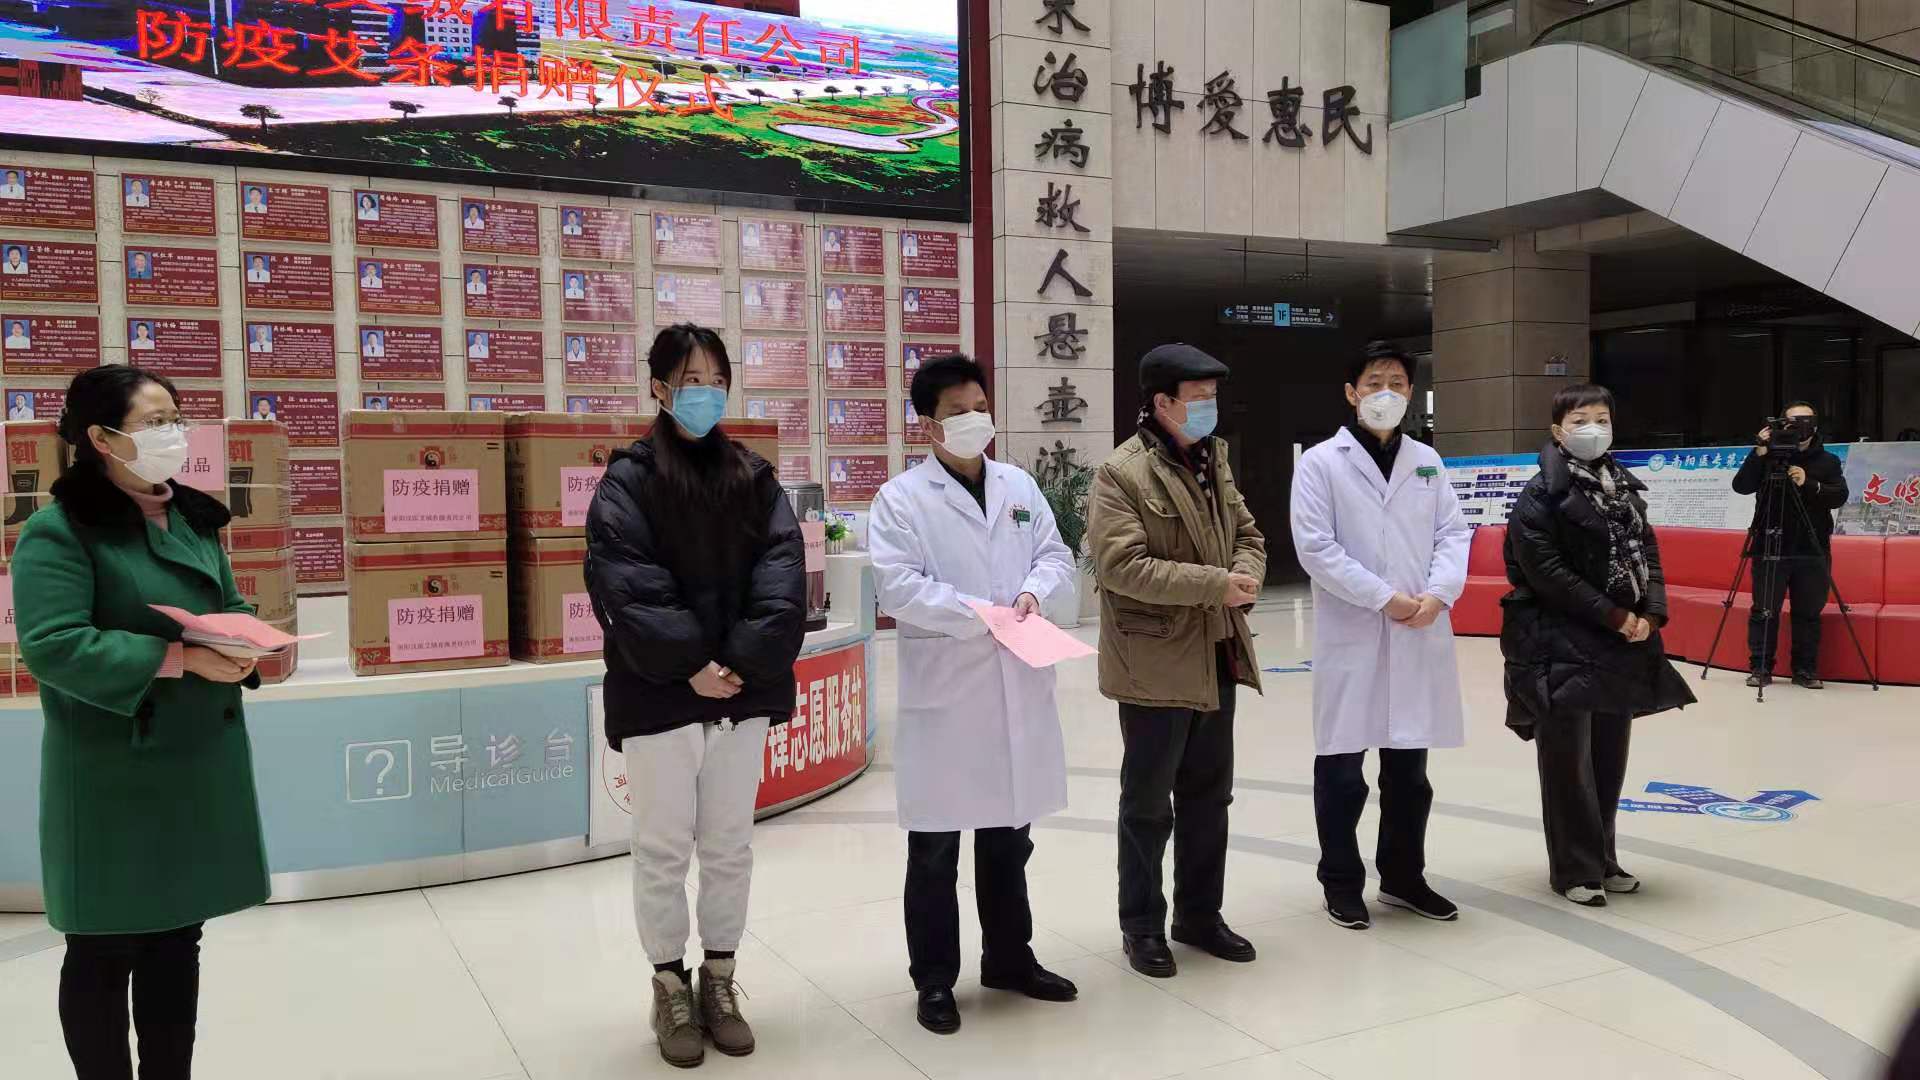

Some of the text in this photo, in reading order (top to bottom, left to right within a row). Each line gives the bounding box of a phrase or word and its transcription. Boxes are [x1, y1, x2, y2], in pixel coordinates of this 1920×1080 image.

[322, 0, 862, 74] 有限责任公司
[137, 9, 736, 122] 防疫艾条捐赠仪式
[392, 478, 470, 497] 防疫捐赠
[397, 604, 475, 625] 防疫捐赠
[760, 664, 862, 783] 辉志愿服务站
[430, 728, 575, 774] 导诊台
[430, 762, 575, 794] MedicalGuide
